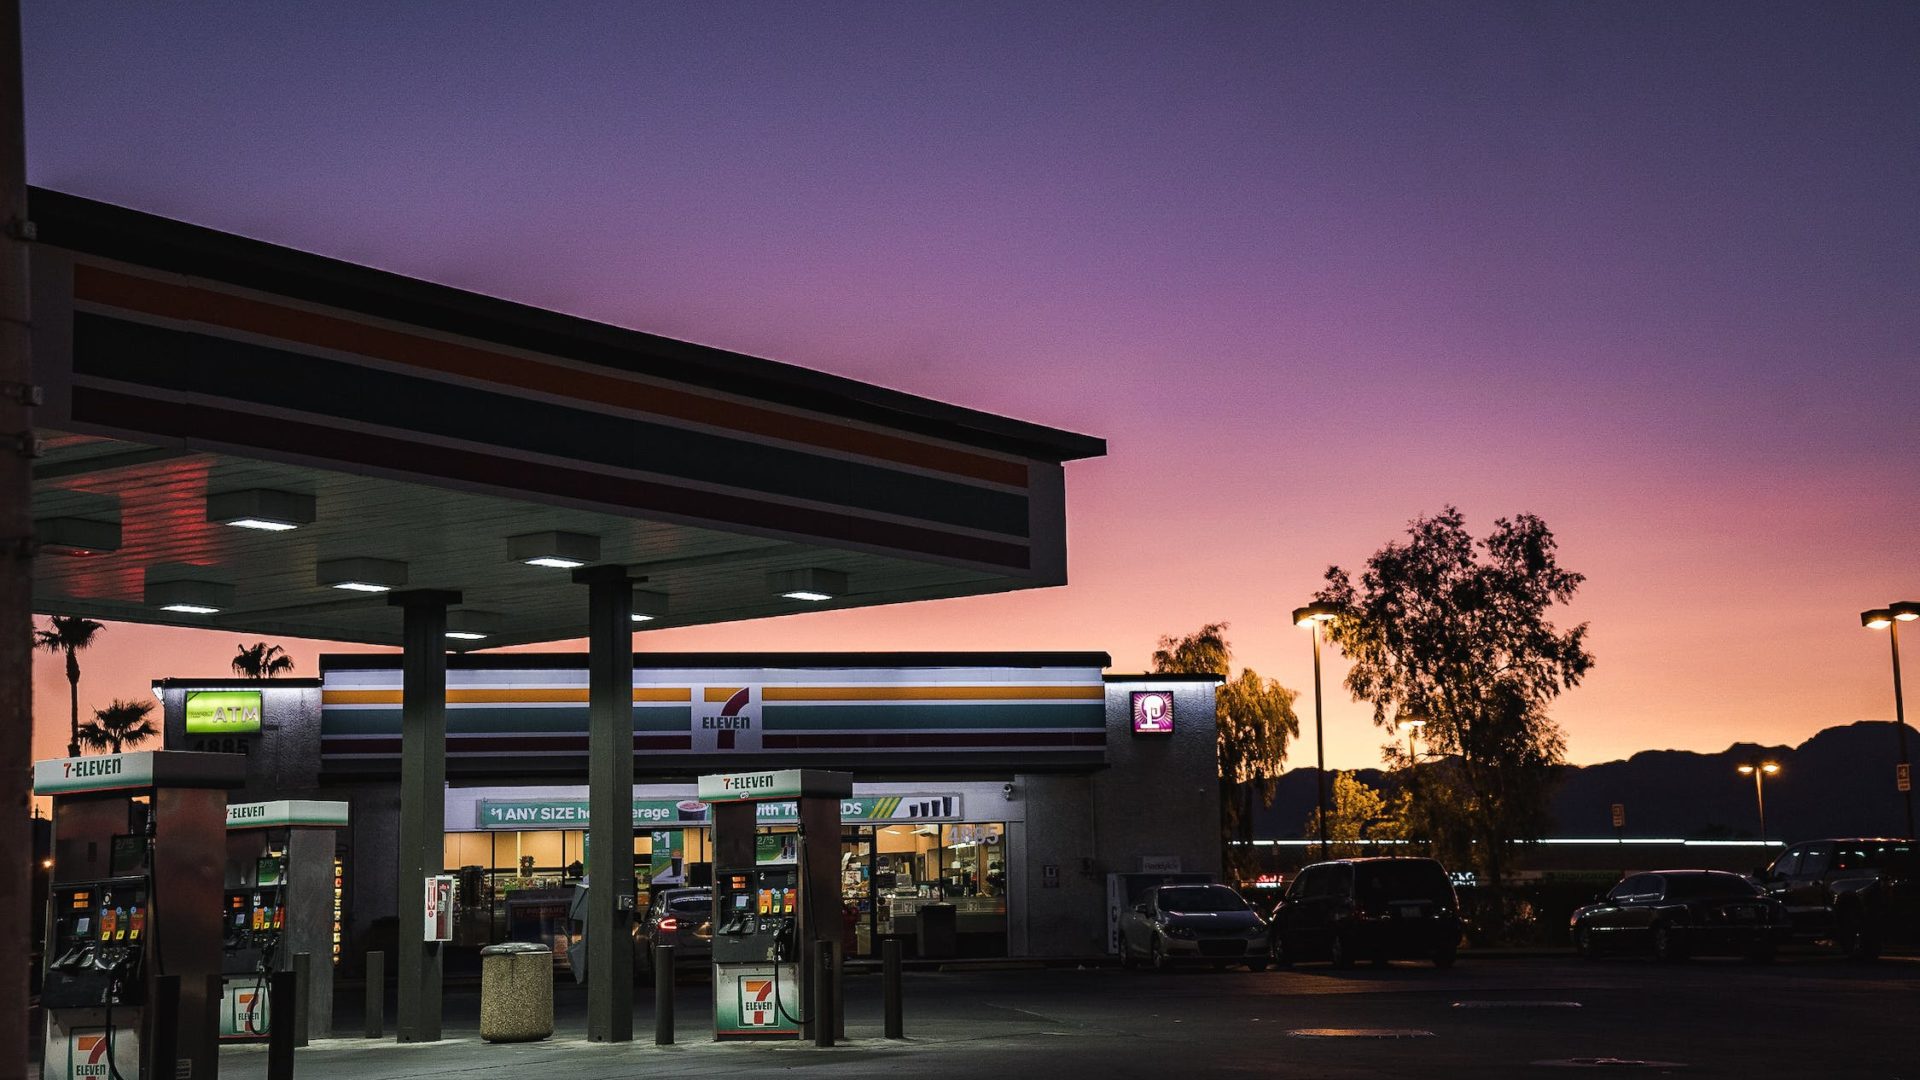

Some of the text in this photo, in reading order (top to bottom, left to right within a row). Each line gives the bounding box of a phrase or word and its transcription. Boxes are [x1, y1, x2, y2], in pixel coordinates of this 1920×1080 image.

[213, 706, 259, 723] ATM
[702, 716, 750, 729] ELEVEN
[63, 757, 122, 778] 7-ELEVEN
[723, 774, 774, 789] 7-ELEVEN
[490, 808, 503, 821] $1
[505, 807, 538, 820] ANY
[540, 807, 575, 820] SIZE
[632, 808, 670, 820] erage
[653, 831, 671, 849] $1
[746, 1001, 773, 1011] ELEVEN
[76, 1064, 106, 1076] ELEVEN
